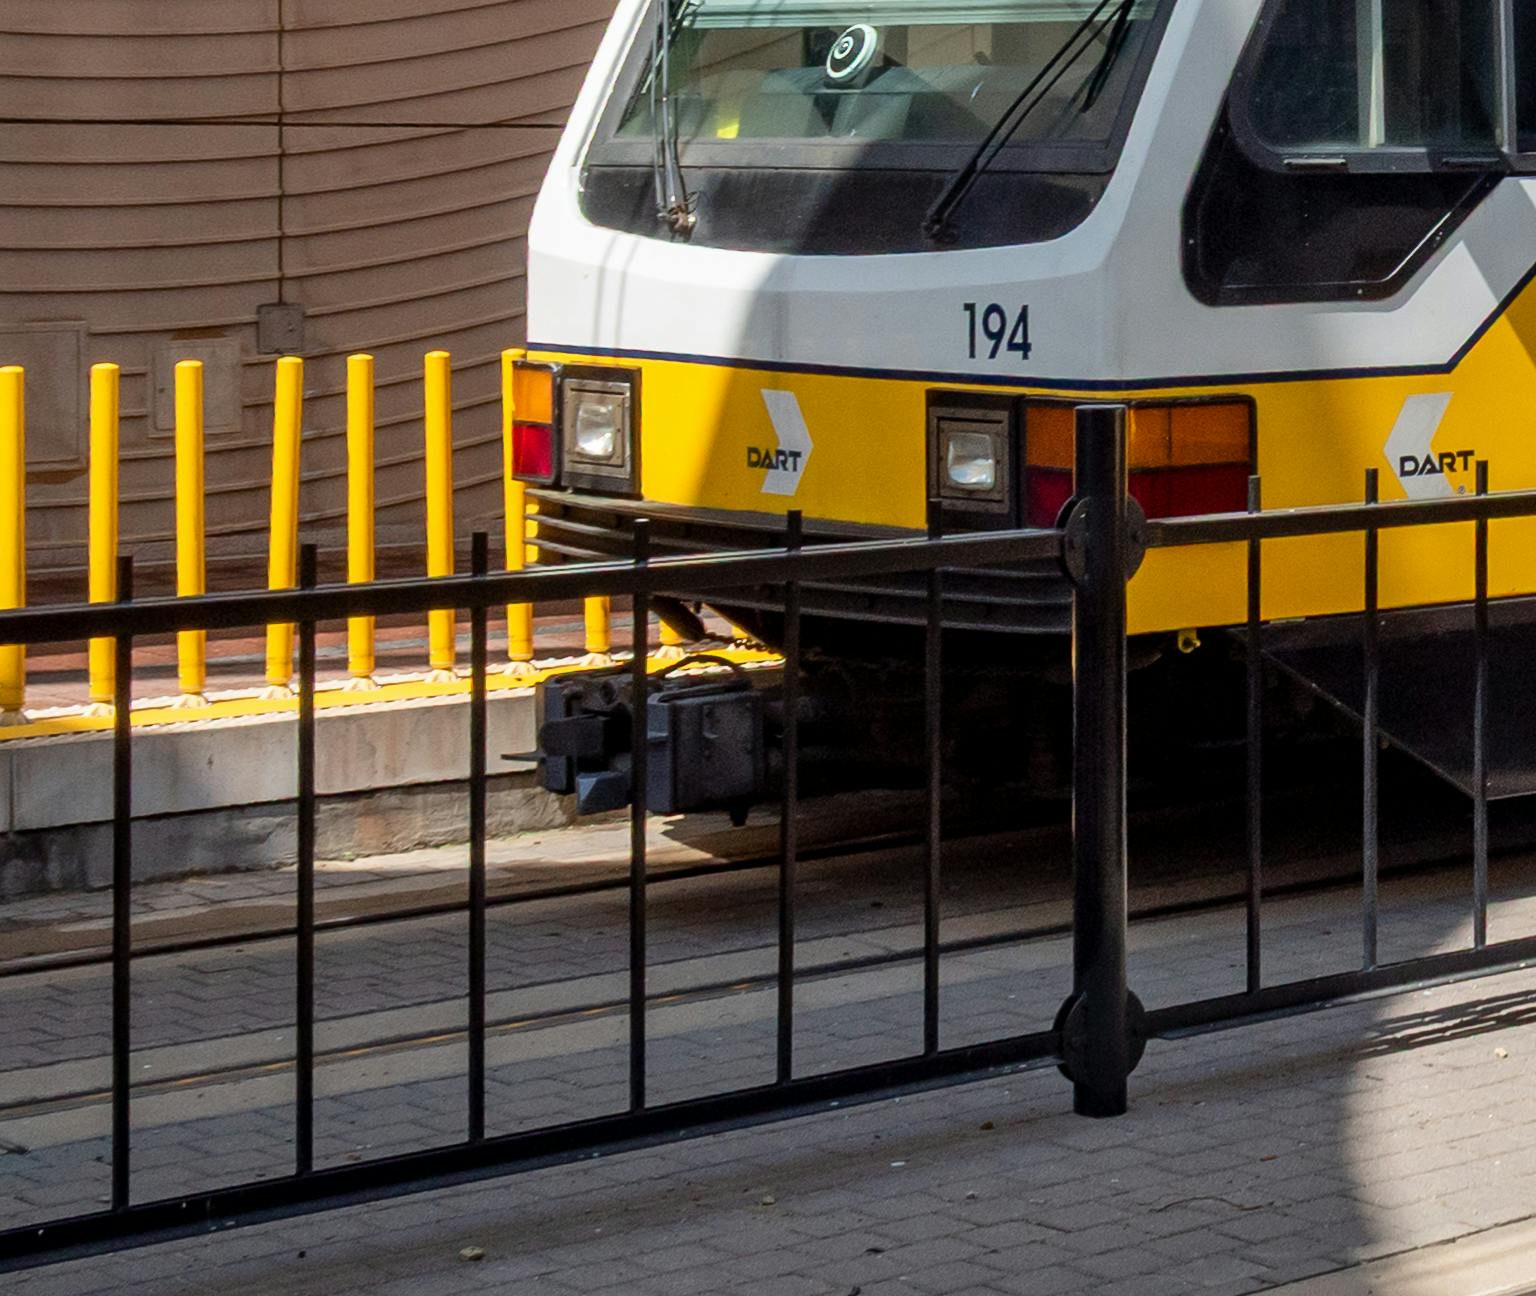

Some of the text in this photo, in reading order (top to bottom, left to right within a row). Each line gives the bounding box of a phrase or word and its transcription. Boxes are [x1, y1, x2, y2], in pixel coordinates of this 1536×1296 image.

[963, 301, 1033, 361] 194
[746, 445, 803, 474] DART
[1398, 449, 1475, 478] DART
